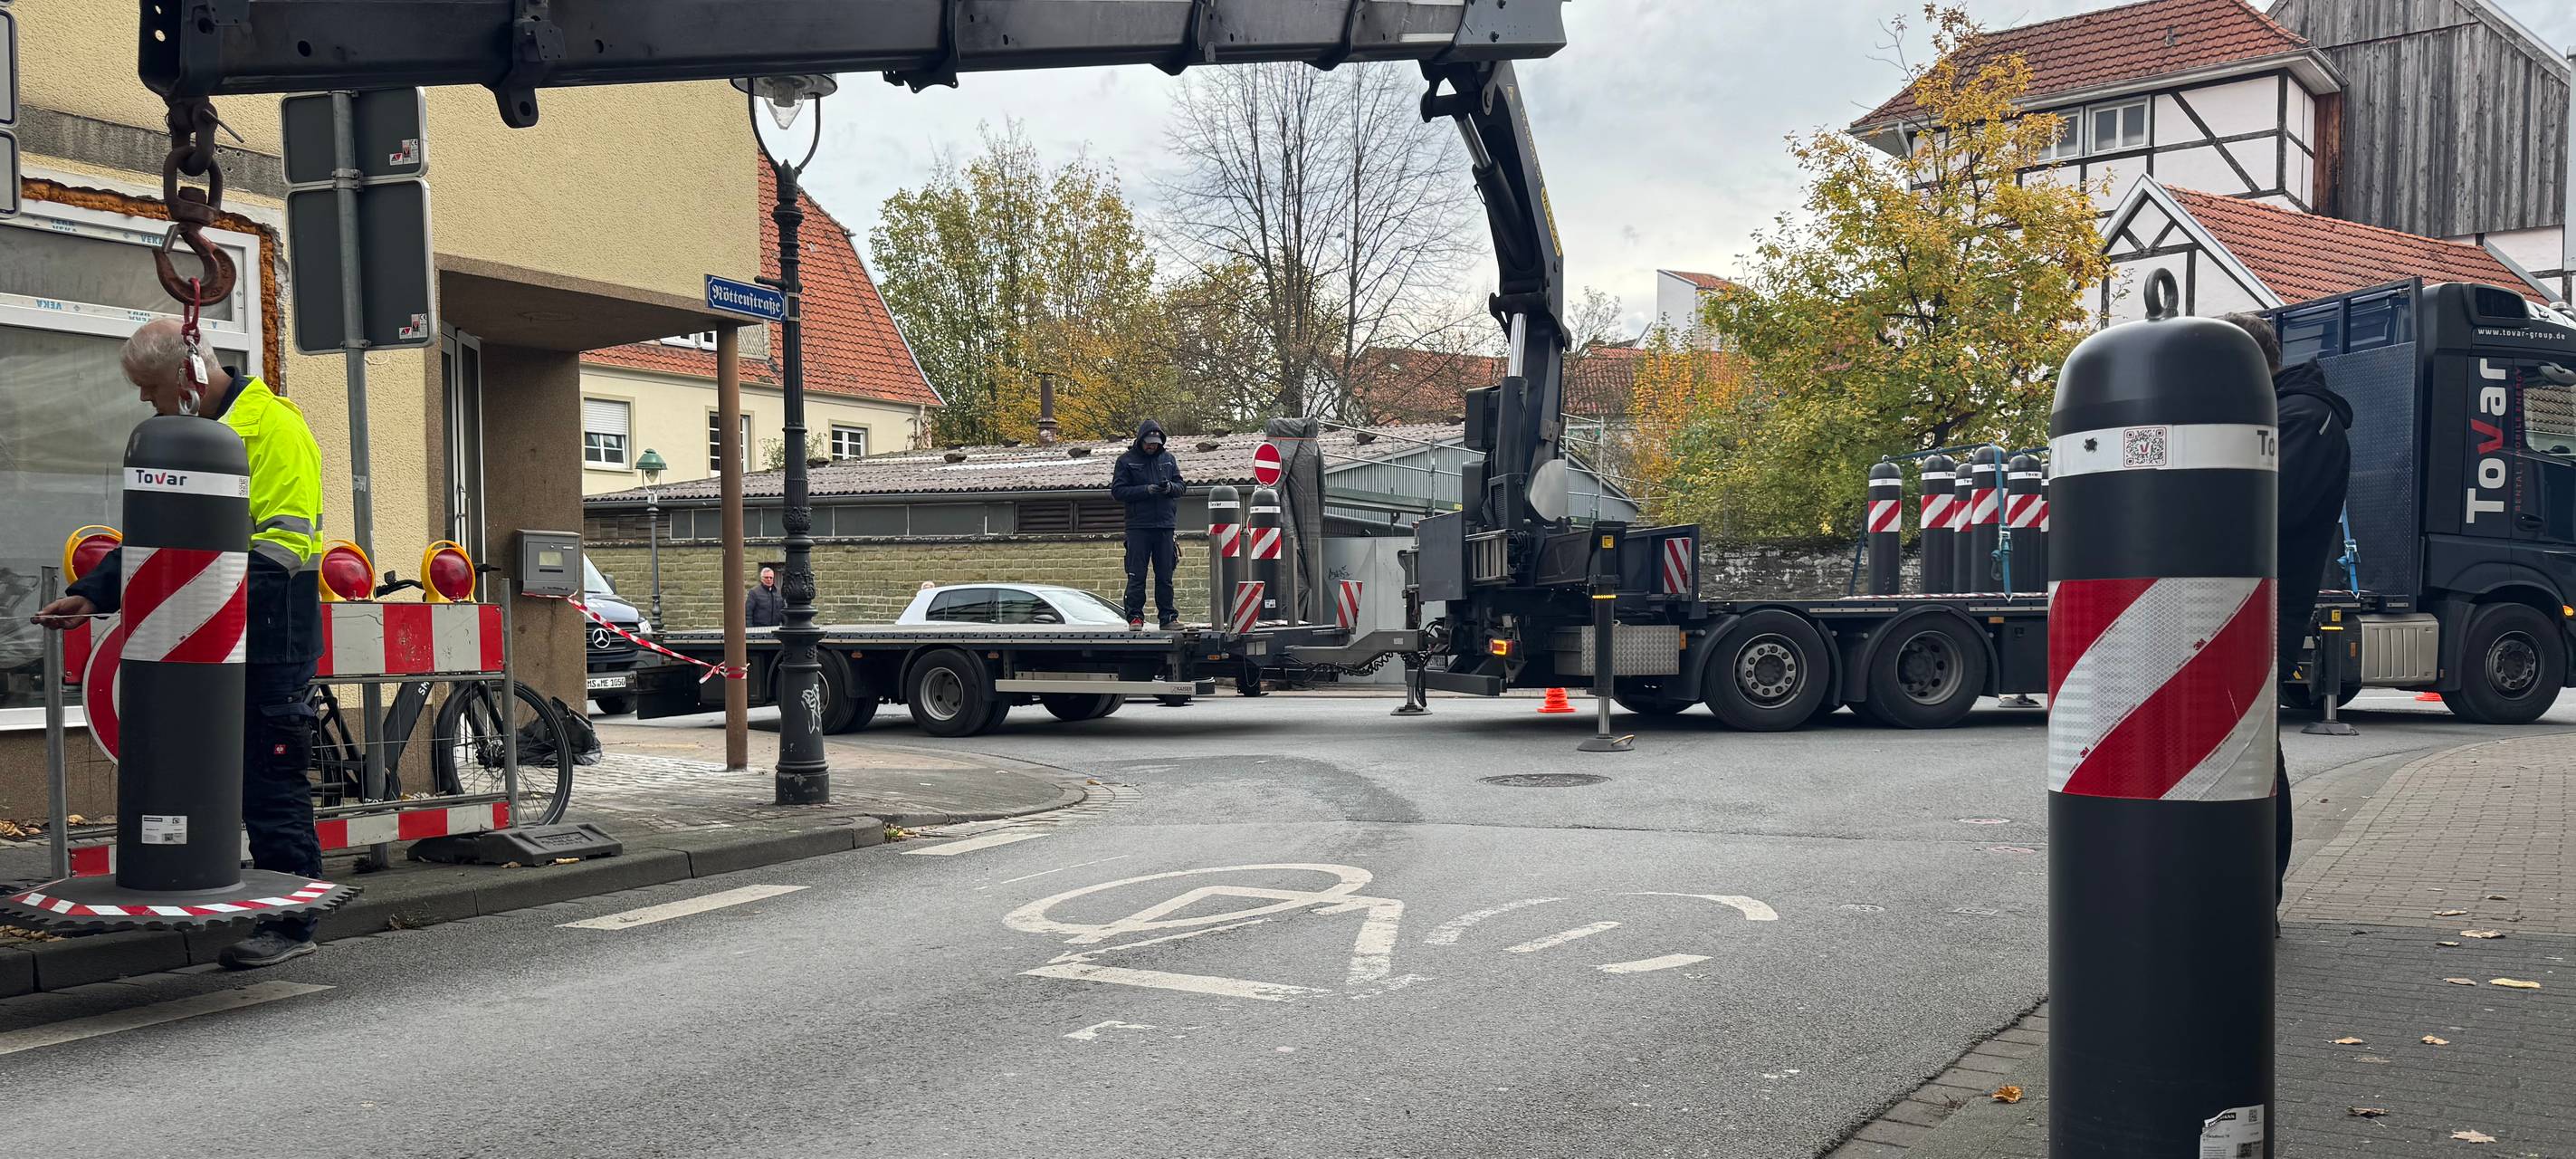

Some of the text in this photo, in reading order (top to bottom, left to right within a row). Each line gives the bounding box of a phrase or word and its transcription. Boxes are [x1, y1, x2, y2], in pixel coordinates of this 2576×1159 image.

[2477, 328, 2566, 340] www.tovar-group.de
[2466, 358, 2507, 524] Tovar
[135, 469, 187, 486] Tovar
[2514, 470, 2524, 512] RENTAL
[610, 678, 625, 687] 1050
